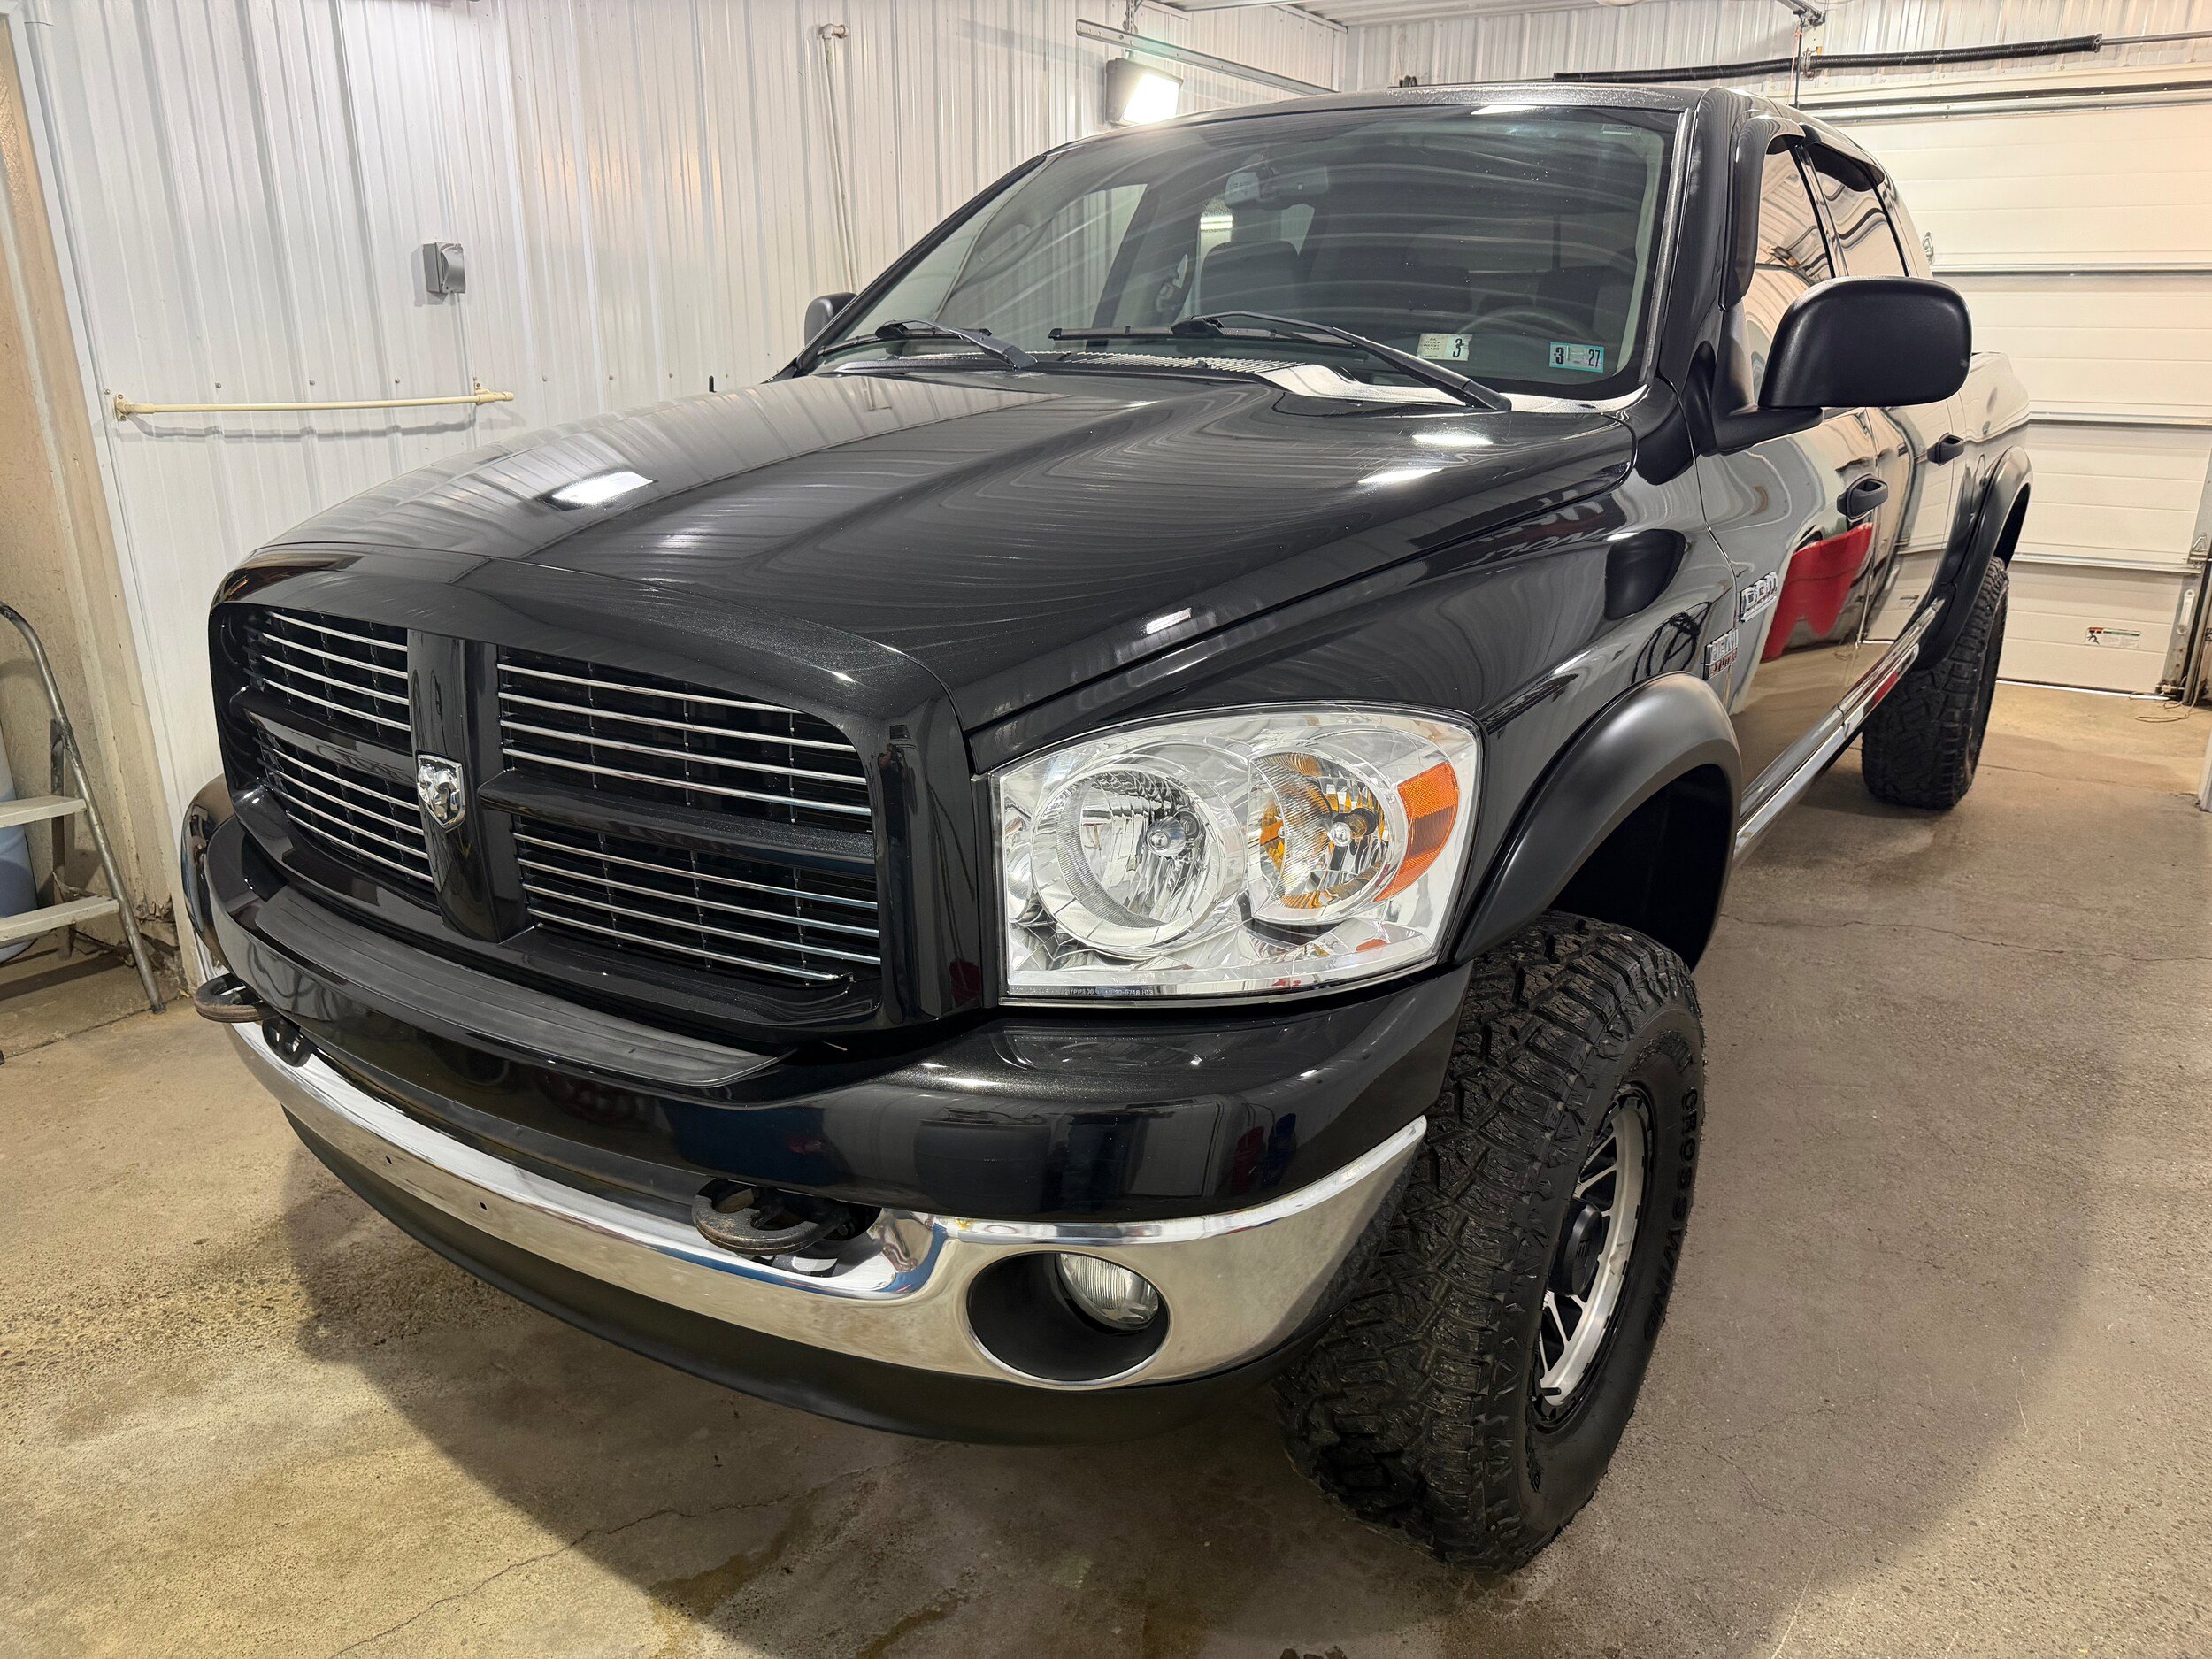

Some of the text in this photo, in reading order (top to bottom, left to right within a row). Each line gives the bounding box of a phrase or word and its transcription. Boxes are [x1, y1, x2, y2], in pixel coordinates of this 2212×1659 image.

[1452, 338, 1465, 358] 3
[1555, 346, 1601, 368] 3 27
[1644, 1087, 1700, 1342] CROSSWIND
